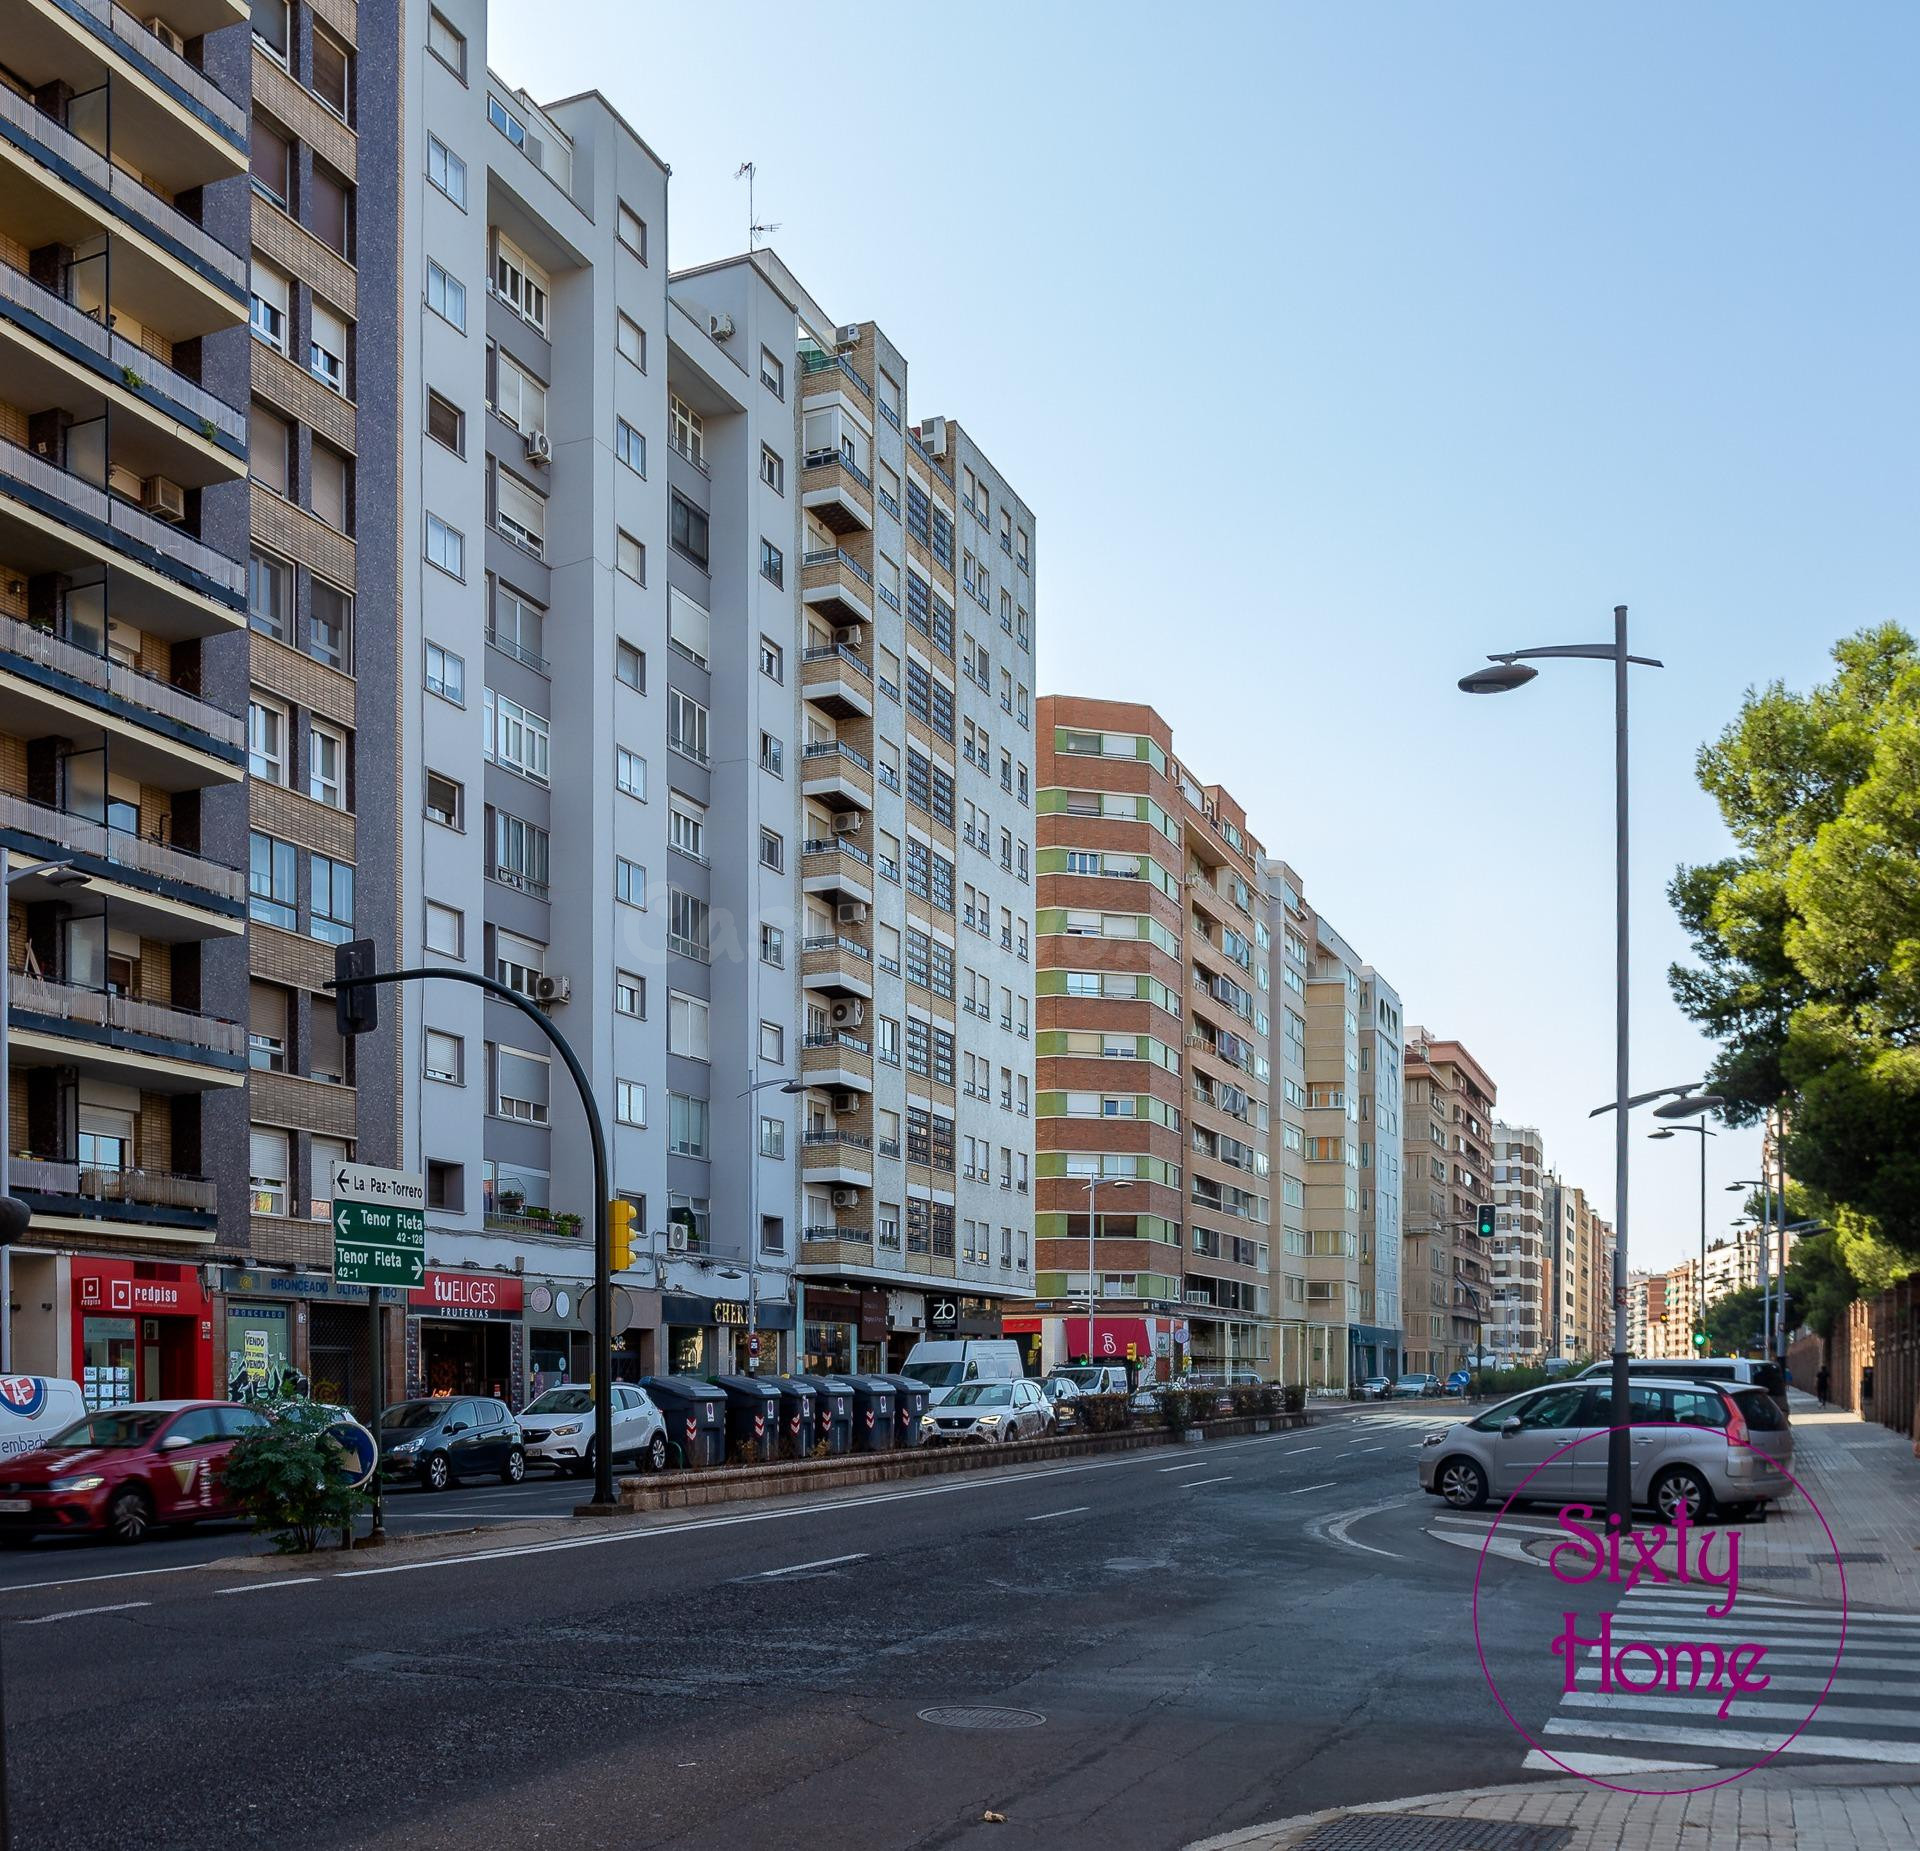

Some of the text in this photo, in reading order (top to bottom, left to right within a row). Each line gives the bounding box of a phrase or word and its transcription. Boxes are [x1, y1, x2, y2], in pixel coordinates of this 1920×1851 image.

[354, 1176, 423, 1199] La Paz-Torrero
[361, 1209, 423, 1231] Tenor Fleta
[396, 1232, 424, 1245] 42-128
[337, 1247, 402, 1268] Tenor Fleta
[337, 1267, 359, 1278] 42-1
[270, 1278, 329, 1294] BRONCEADO
[134, 1286, 177, 1303] redpiso
[81, 1299, 101, 1307] redpiso
[228, 1309, 283, 1319] BRONCEADO
[441, 1307, 489, 1318] FRUTERIAS
[245, 1336, 265, 1347] VENDO
[246, 1360, 266, 1370] VENDO
